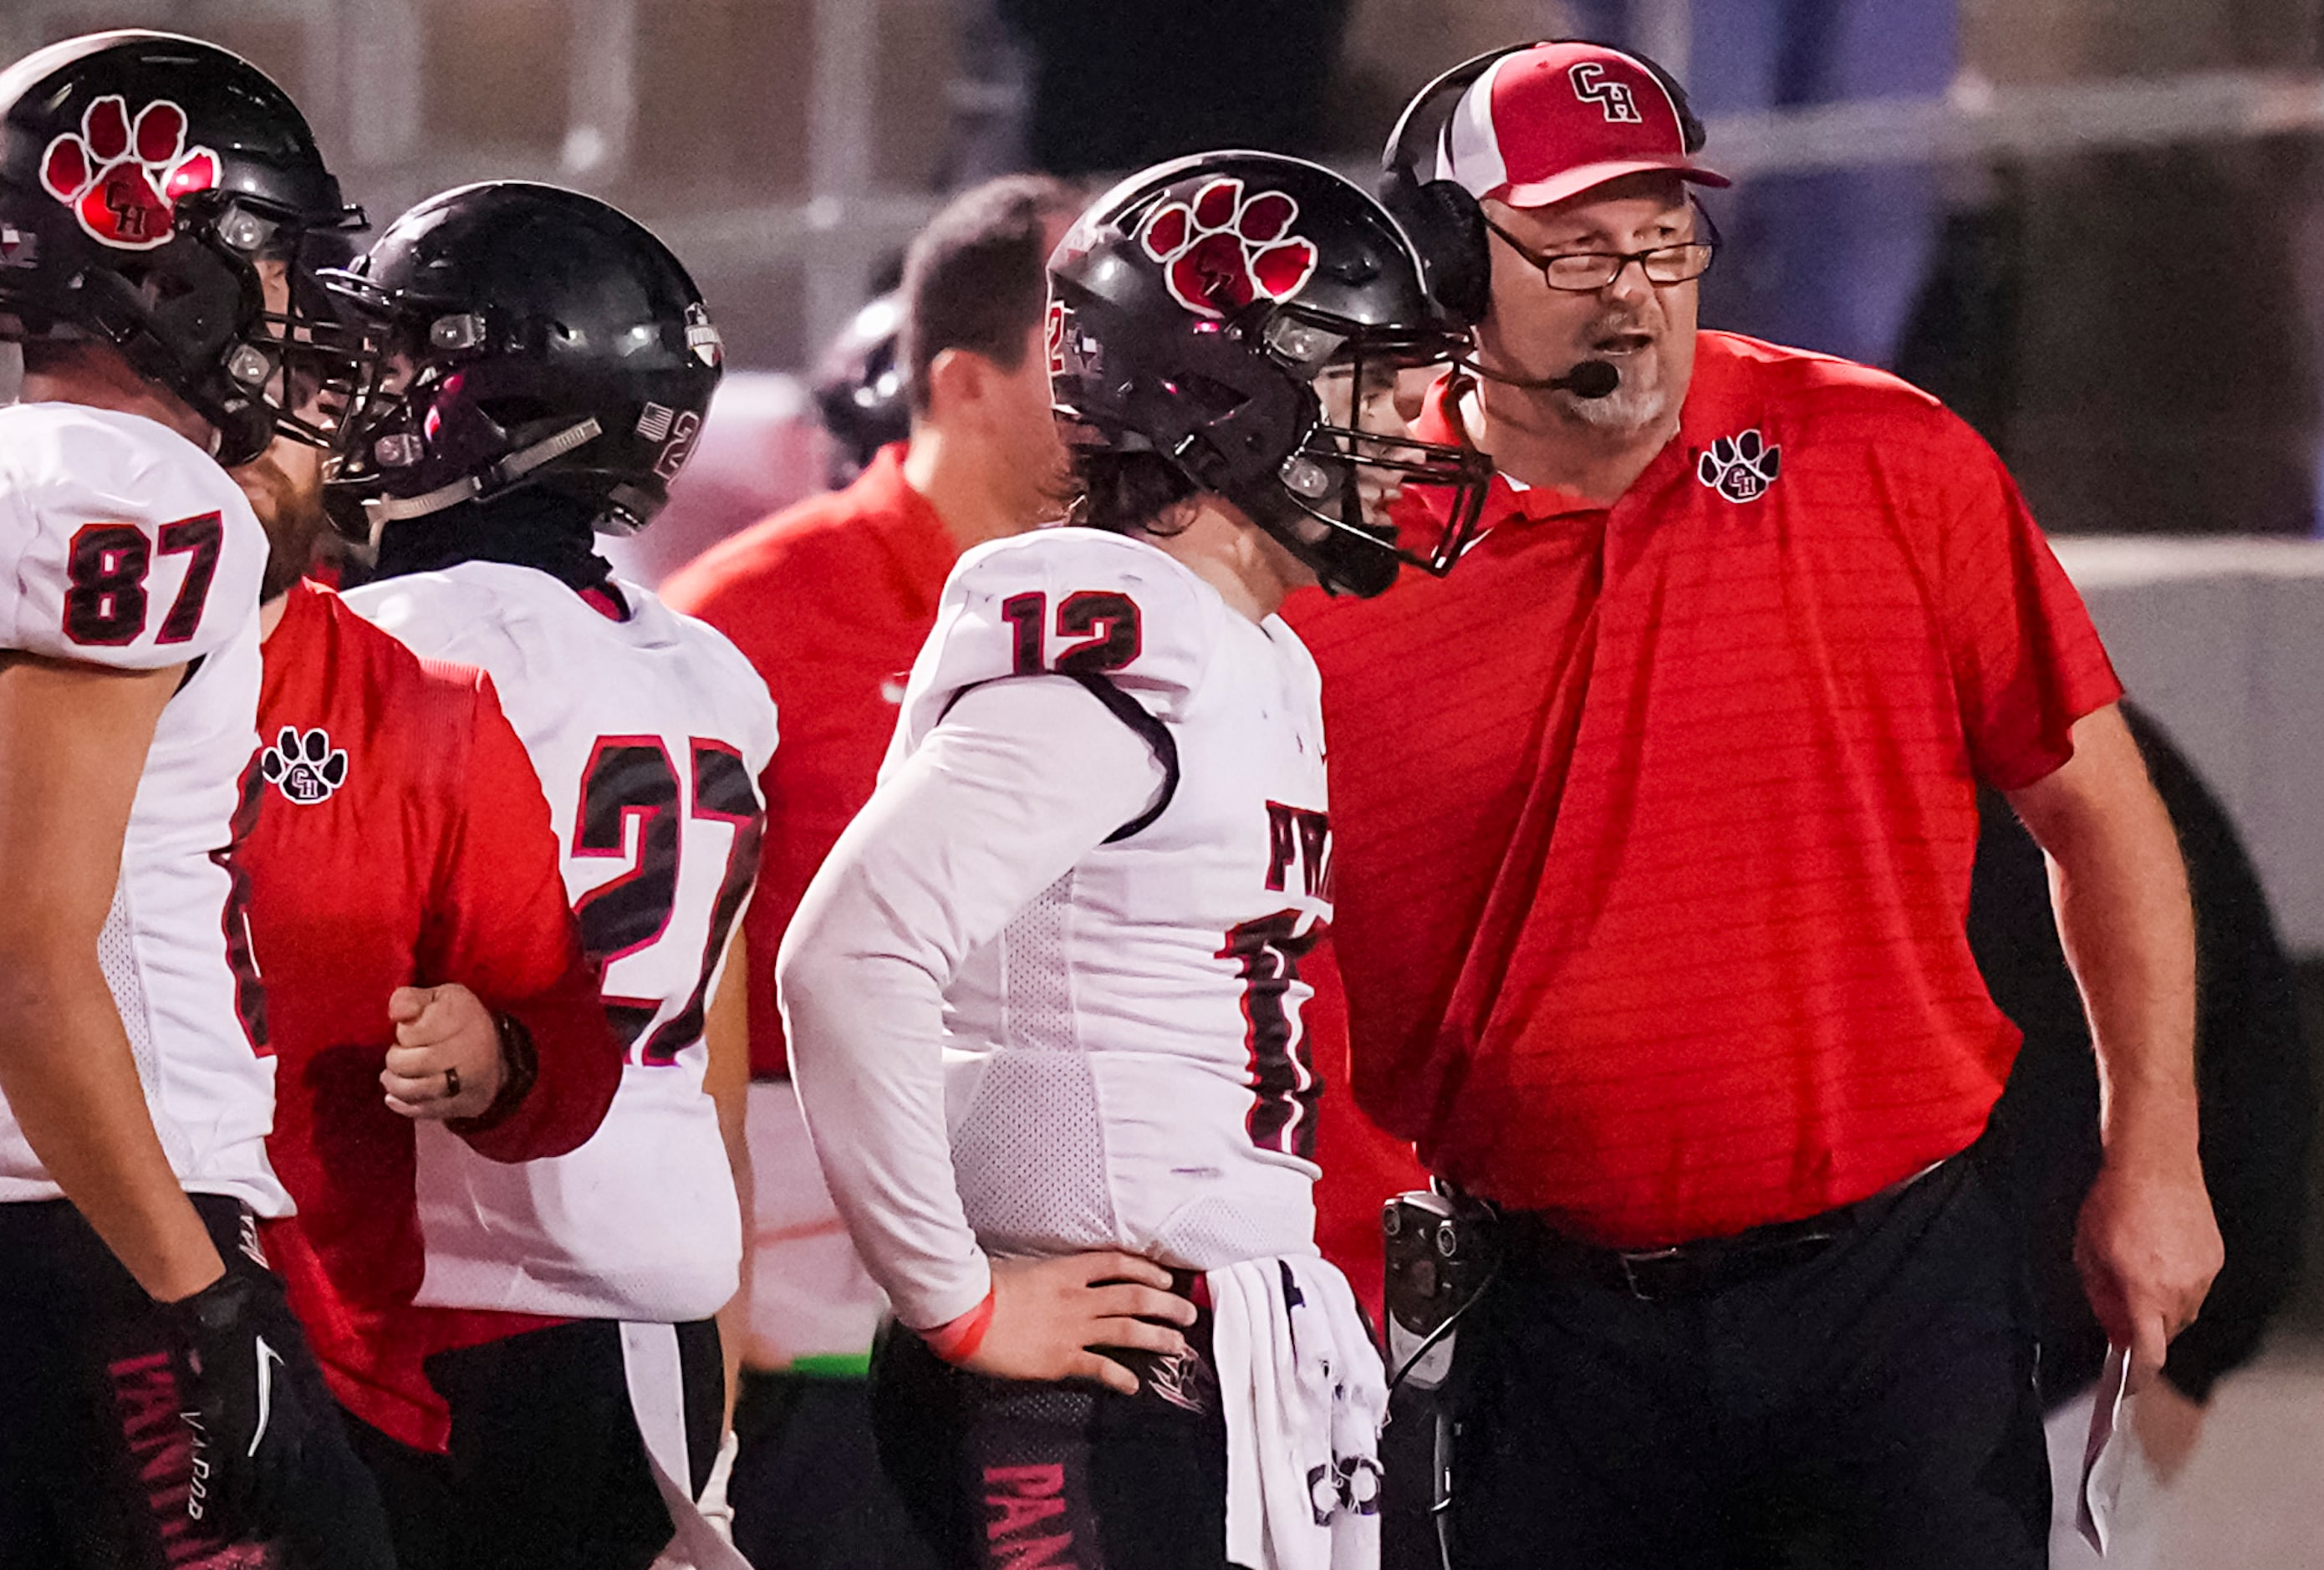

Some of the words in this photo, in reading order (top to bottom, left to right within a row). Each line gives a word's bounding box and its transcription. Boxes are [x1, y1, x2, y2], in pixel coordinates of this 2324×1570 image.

[1567, 62, 1643, 124] CH
[1729, 466, 1756, 497] CH
[63, 511, 223, 646] 87
[1003, 591, 1141, 674] 12
[292, 767, 319, 798] CH
[571, 734, 767, 1068] 27
